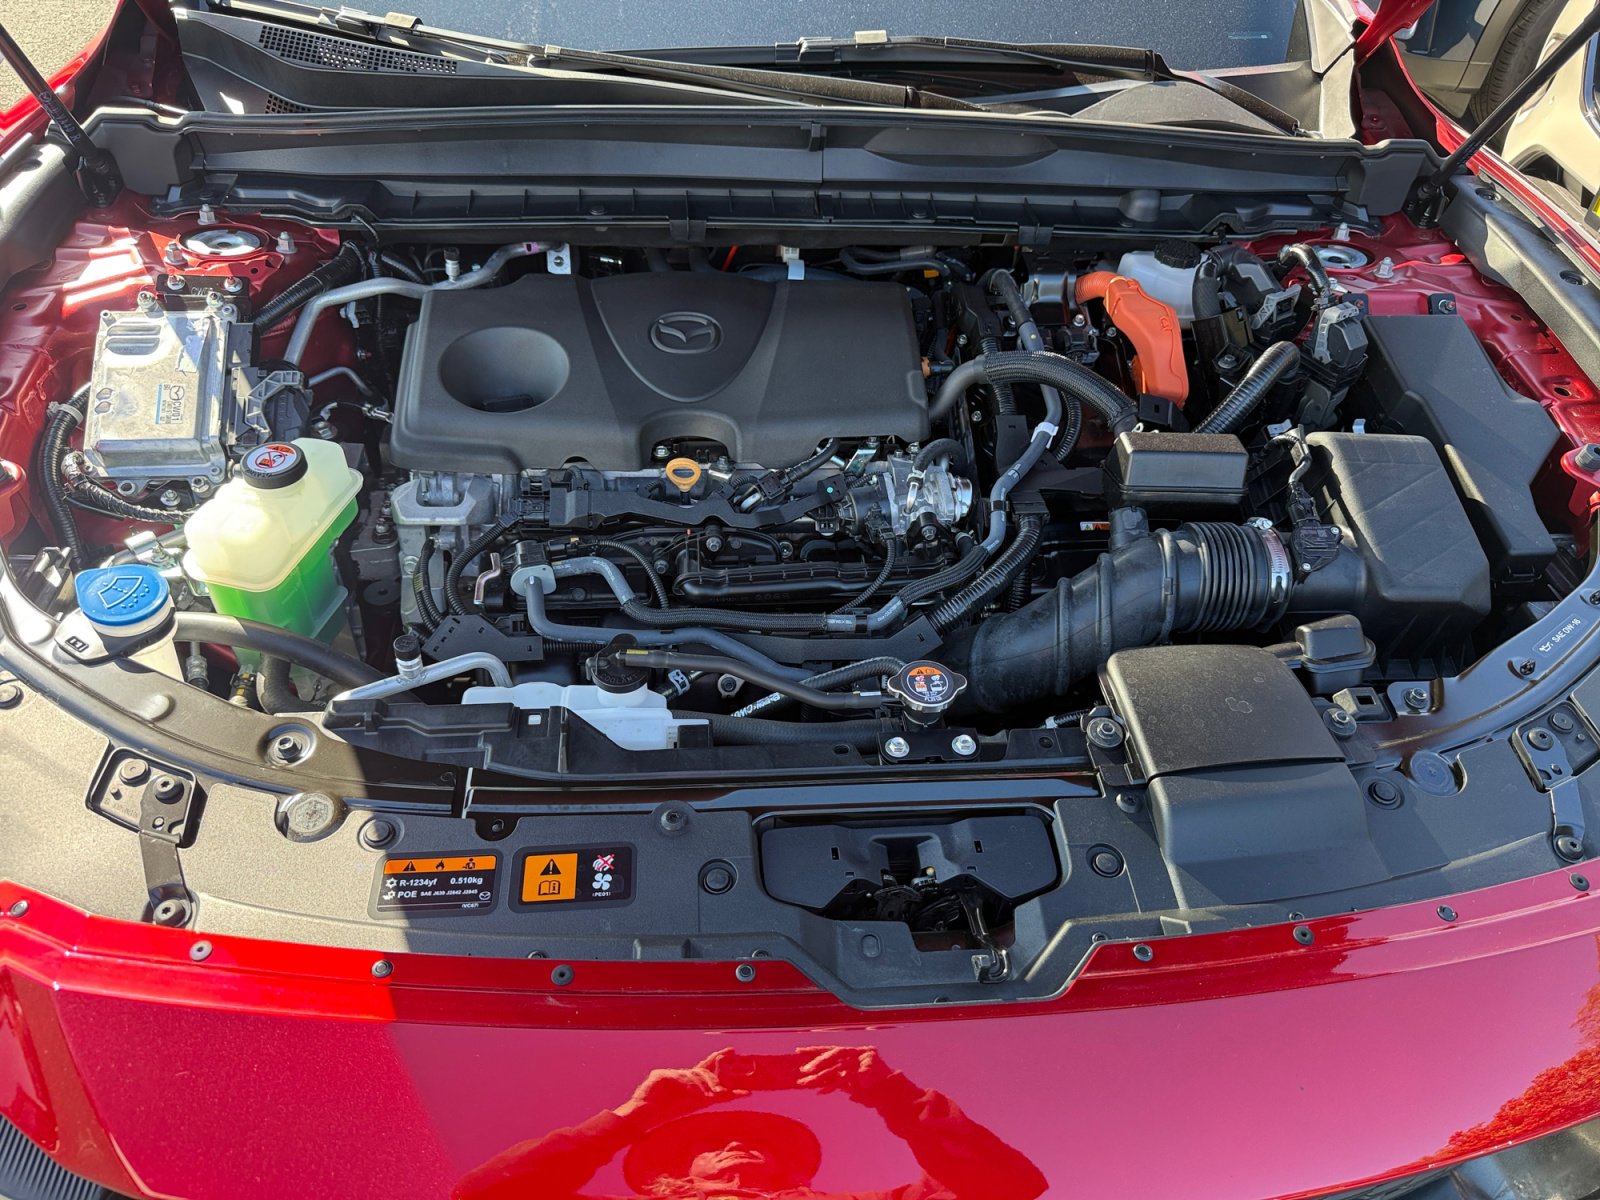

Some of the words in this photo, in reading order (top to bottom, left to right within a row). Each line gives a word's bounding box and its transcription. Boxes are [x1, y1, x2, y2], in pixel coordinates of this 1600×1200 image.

[1552, 631, 1566, 642] SAE
[400, 878, 437, 887] R-1234yf
[450, 877, 483, 885] 0.510kg
